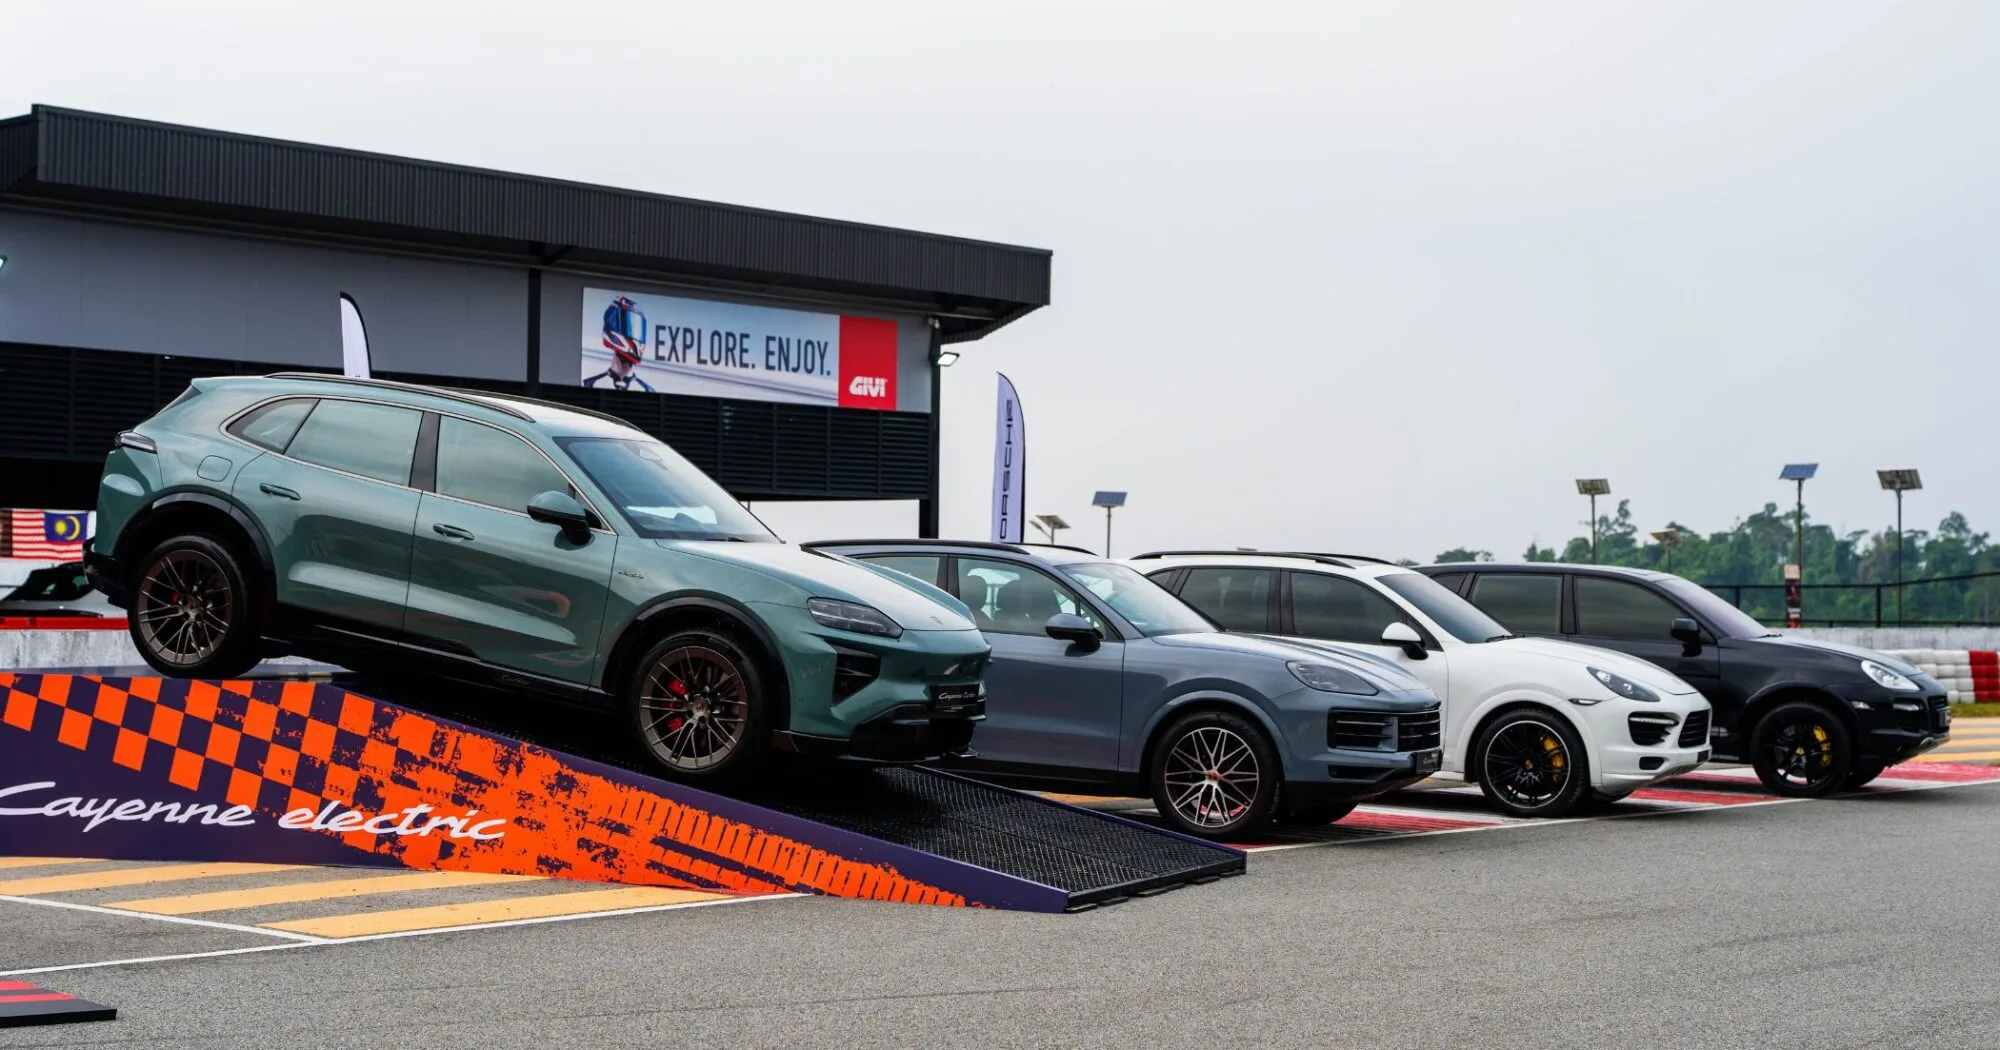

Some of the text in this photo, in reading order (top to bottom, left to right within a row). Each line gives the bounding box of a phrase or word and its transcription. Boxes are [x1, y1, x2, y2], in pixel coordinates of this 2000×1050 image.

[654, 324, 831, 377] EXPLORE. ENJOY.
[849, 376, 886, 398] GIVI
[1000, 399, 1013, 540] ORSCHE
[0, 781, 506, 840] Cayenne electric
